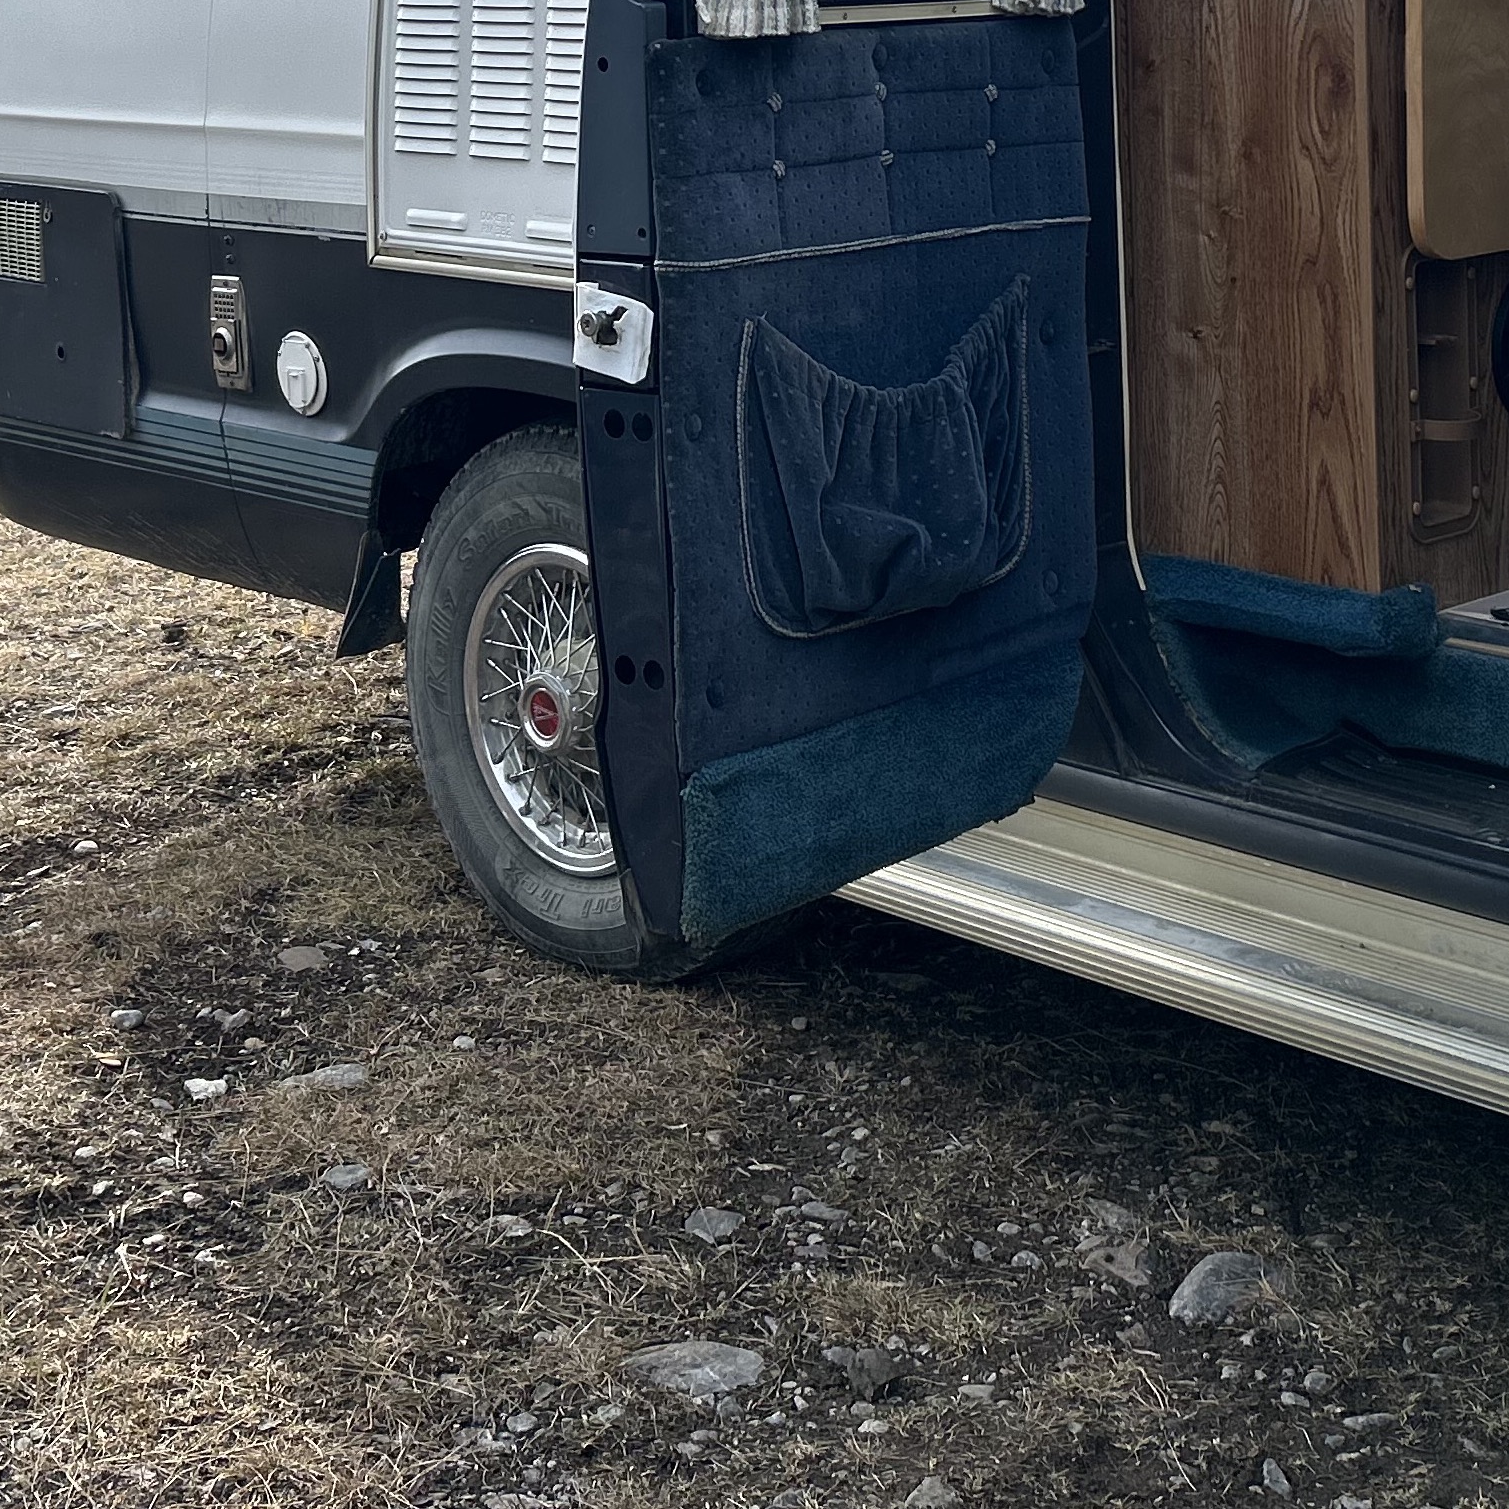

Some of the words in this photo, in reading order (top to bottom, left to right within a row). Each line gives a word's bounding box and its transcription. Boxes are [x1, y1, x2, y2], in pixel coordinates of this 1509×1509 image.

[458, 502, 533, 564] Safari
[426, 584, 458, 695] Kelly
[503, 859, 565, 921] Trex
[580, 894, 622, 919] ari
